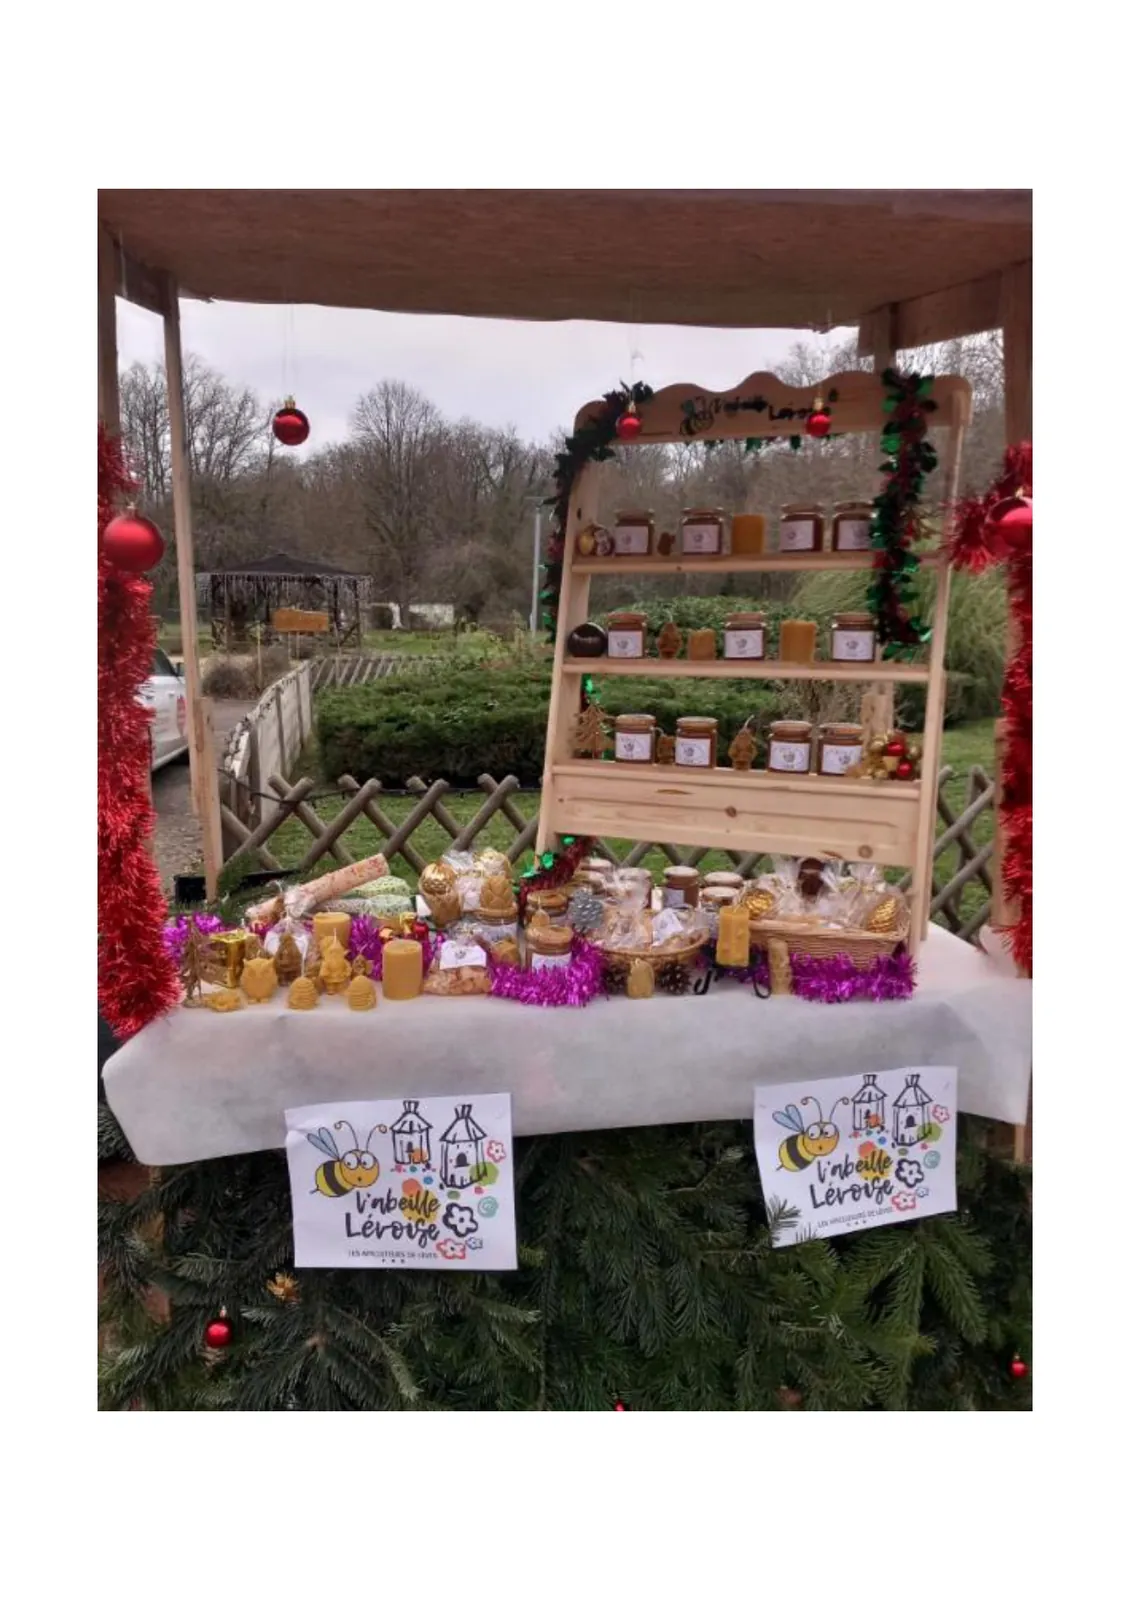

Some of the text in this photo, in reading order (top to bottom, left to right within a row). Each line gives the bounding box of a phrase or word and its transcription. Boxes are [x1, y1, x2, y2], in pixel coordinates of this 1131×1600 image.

[817, 1149, 893, 1184] l'abeille
[356, 1187, 440, 1218] l'abeille
[809, 1176, 894, 1210] Lévoise
[345, 1212, 440, 1248] Lévoise
